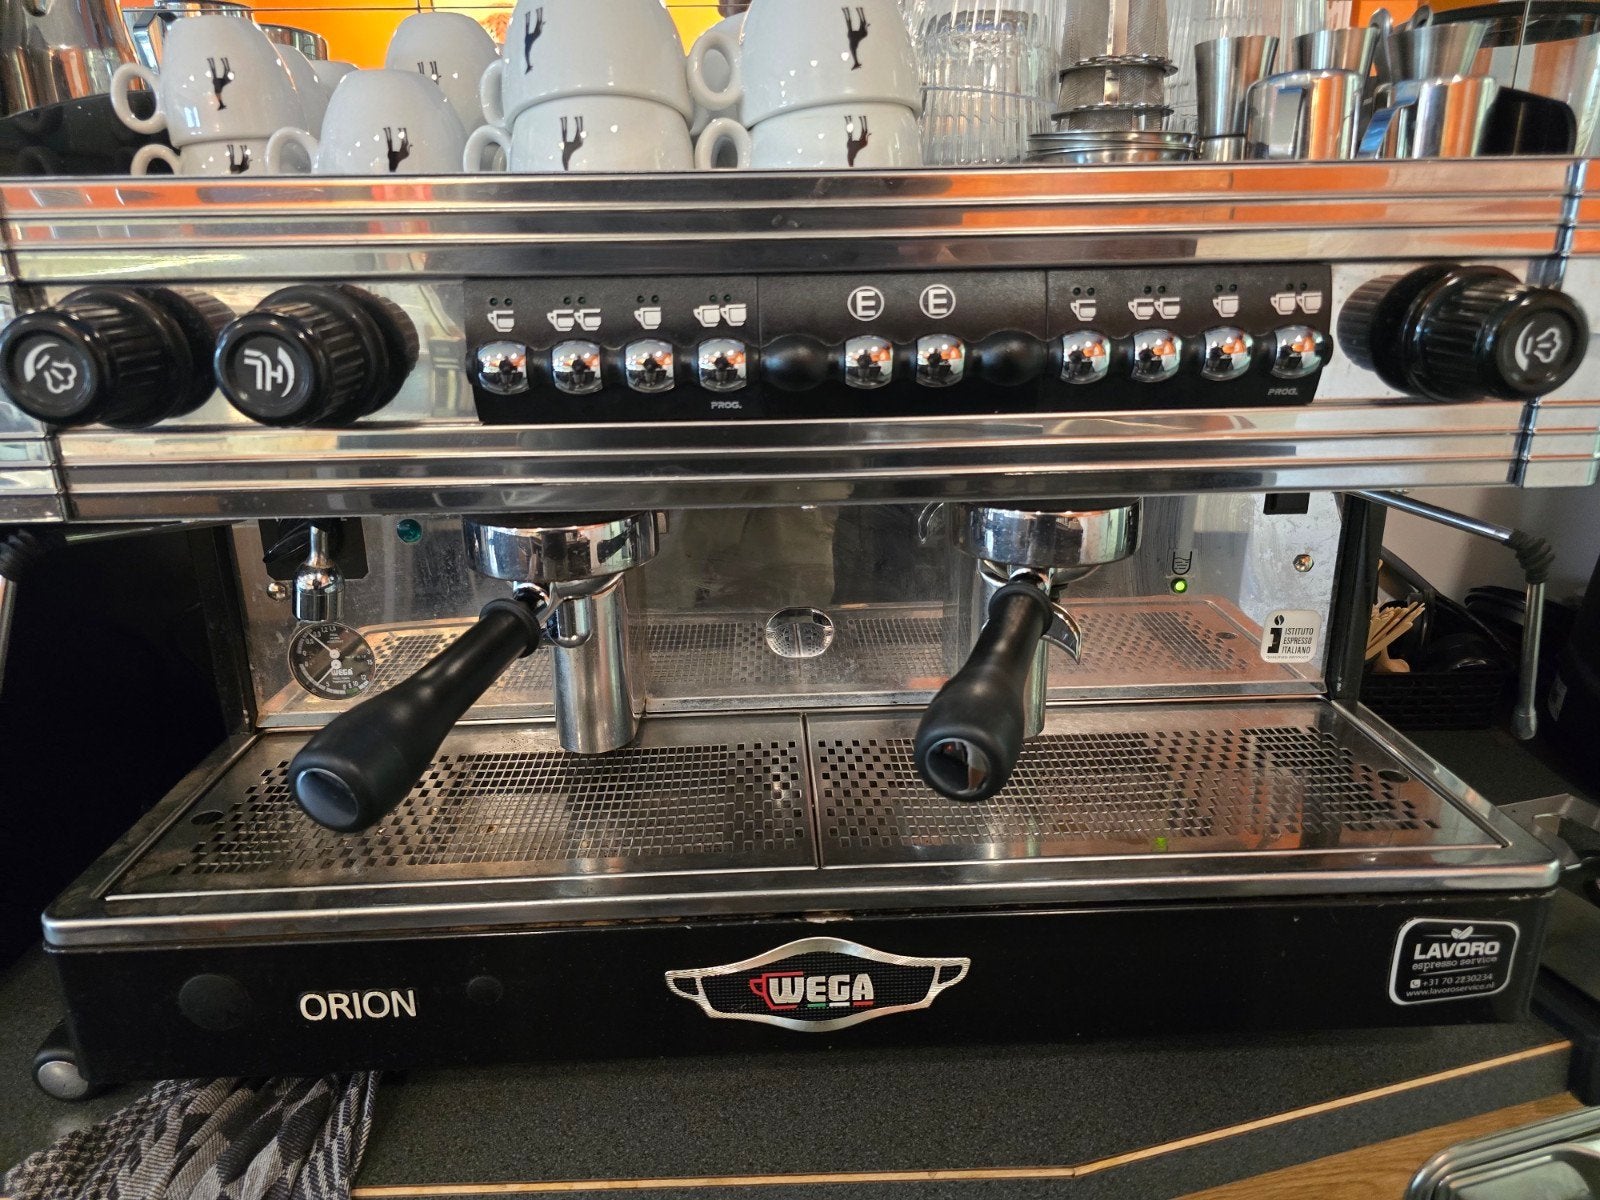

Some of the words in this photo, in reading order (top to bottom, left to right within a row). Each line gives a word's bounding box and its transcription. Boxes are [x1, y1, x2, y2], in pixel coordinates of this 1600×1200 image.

[856, 290, 876, 317] E
[928, 288, 947, 314] E
[1267, 388, 1298, 396] PROG.
[710, 401, 742, 409] PROG.
[1284, 627, 1314, 636] ISTITUTO
[1283, 636, 1313, 645] ESPRESSO
[1281, 646, 1311, 654] ITALIANO
[332, 668, 354, 676] WEGA
[1413, 941, 1500, 960] LAVORO
[1411, 960, 1458, 973] espresso
[1459, 956, 1498, 966] service
[1423, 978, 1439, 987] +31
[1442, 977, 1453, 985] 70
[768, 973, 874, 1005] WEGA
[1406, 981, 1495, 997] www.lavoroservice.nl
[300, 989, 417, 1021] ORION
